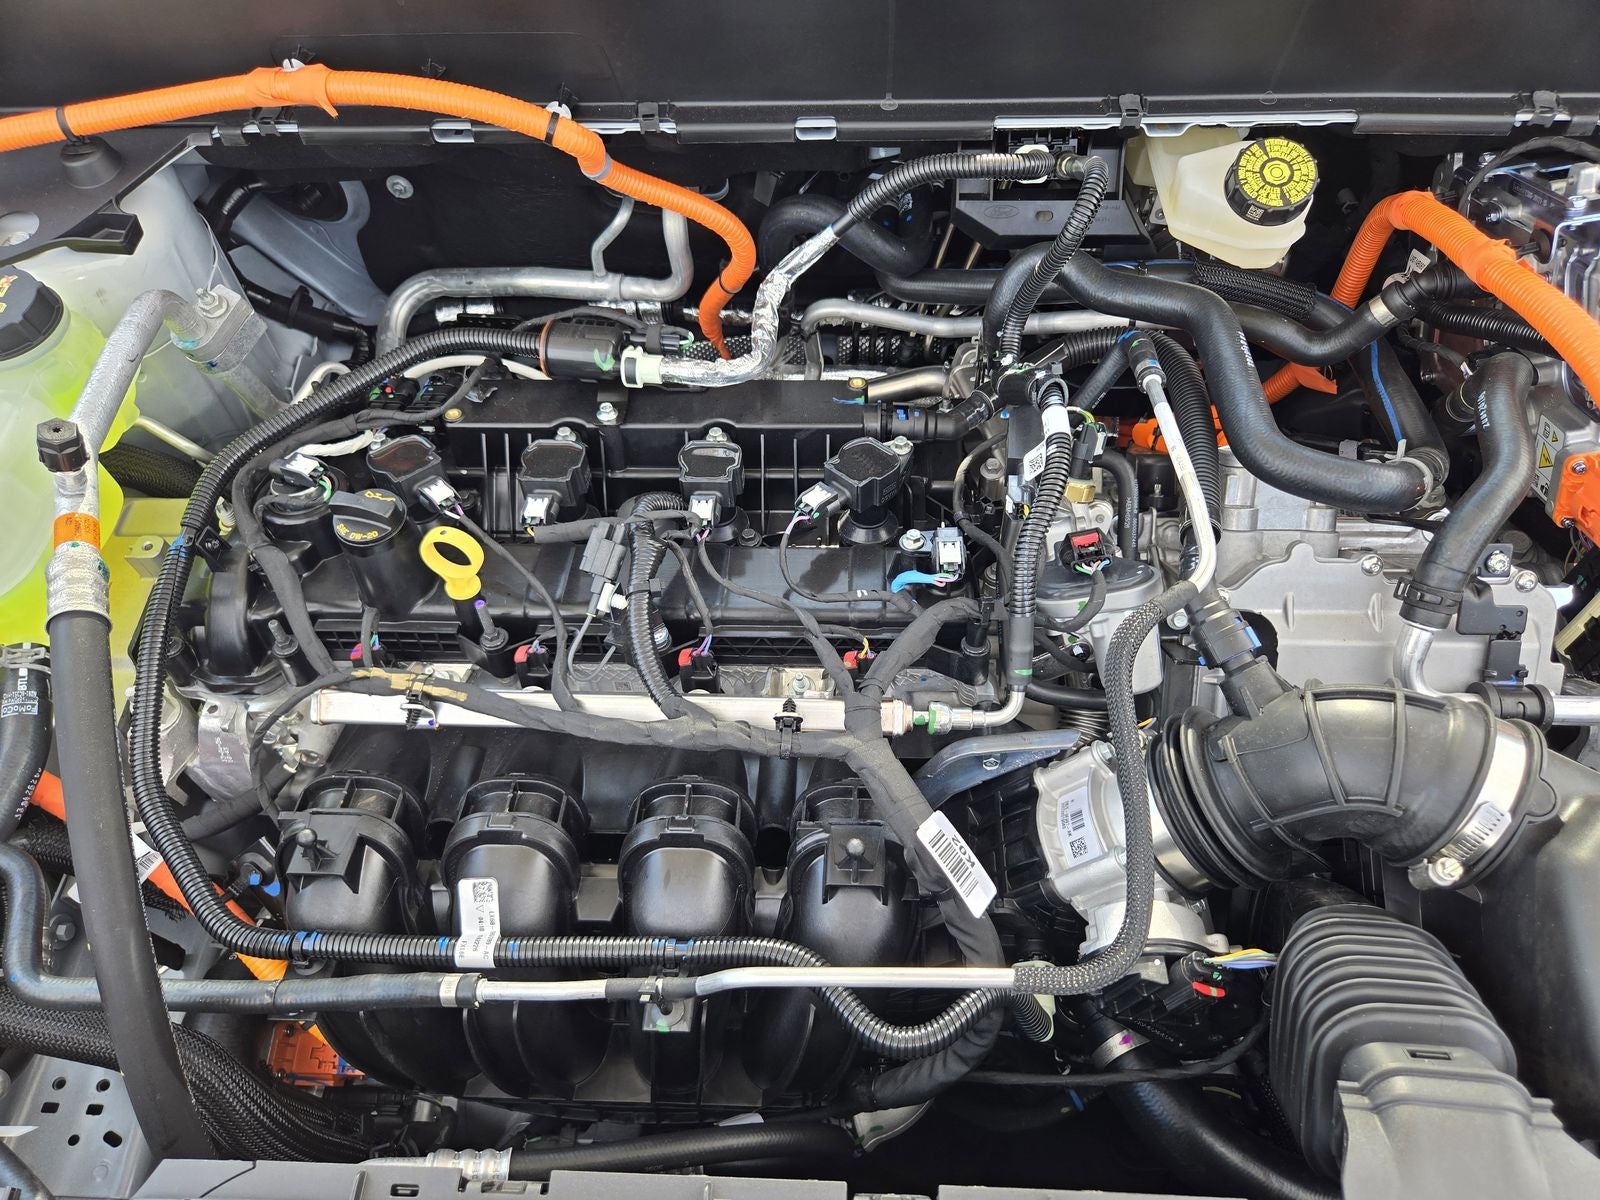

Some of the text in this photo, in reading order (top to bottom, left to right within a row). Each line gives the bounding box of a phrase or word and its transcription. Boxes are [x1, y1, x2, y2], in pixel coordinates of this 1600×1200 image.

[336, 523, 349, 536] SAE
[2, 704, 37, 714] FoMoCo
[951, 834, 975, 868] K02
